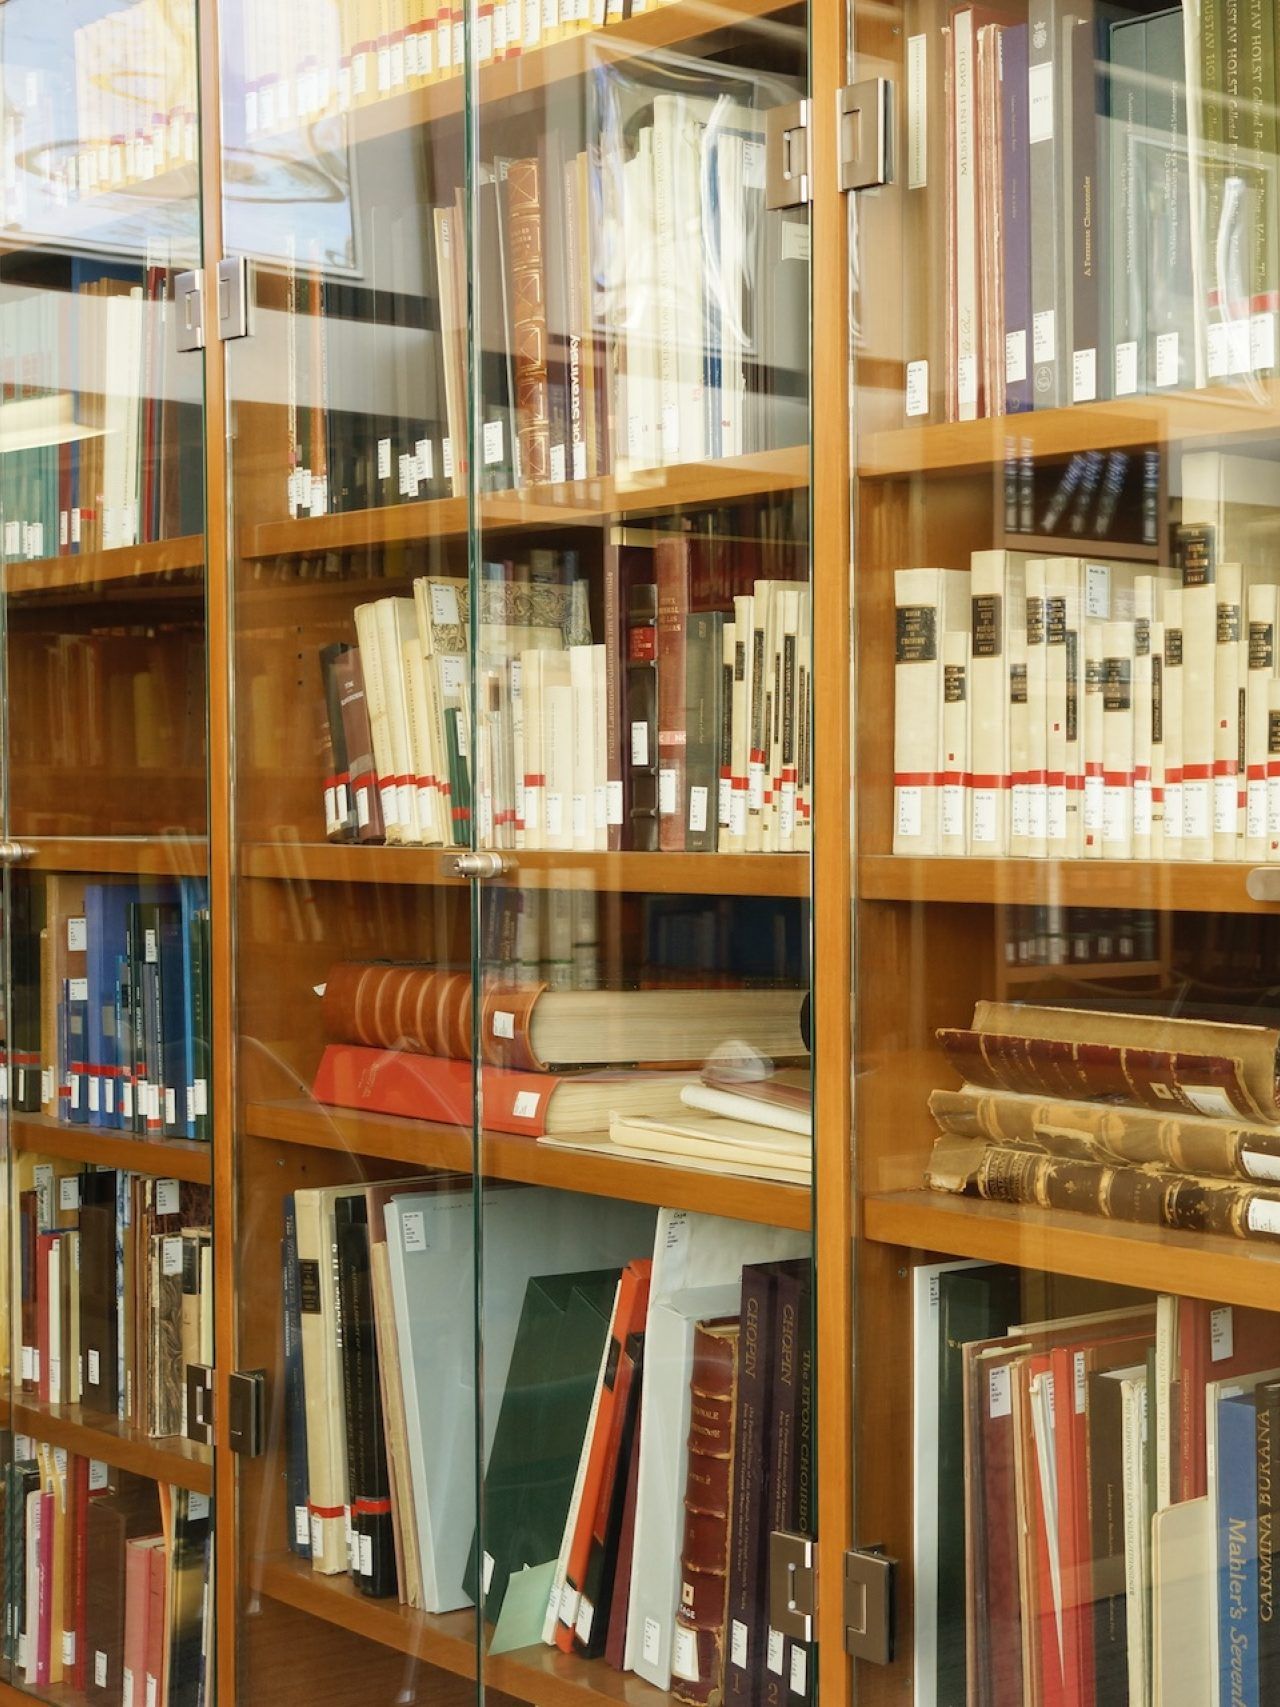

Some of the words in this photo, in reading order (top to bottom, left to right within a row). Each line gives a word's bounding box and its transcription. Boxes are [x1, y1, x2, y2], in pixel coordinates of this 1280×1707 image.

[1204, 0, 1216, 51] USTAV
[1226, 0, 1237, 44] USTAV
[1251, 35, 1262, 82] HOLST
[1226, 49, 1237, 96] HOLST
[569, 335, 582, 419] Stravinsky
[745, 1297, 759, 1378] CHOPIN
[781, 1303, 793, 1386] CHOPIN
[803, 1350, 811, 1380] The
[800, 1385, 810, 1440] ETON
[798, 1443, 811, 1536] CHOIRBO
[1256, 1408, 1272, 1507] BURANA
[1228, 1516, 1249, 1620] Mahler's
[1258, 1513, 1274, 1622] CARMINA
[1229, 1625, 1249, 1707] Sevent
